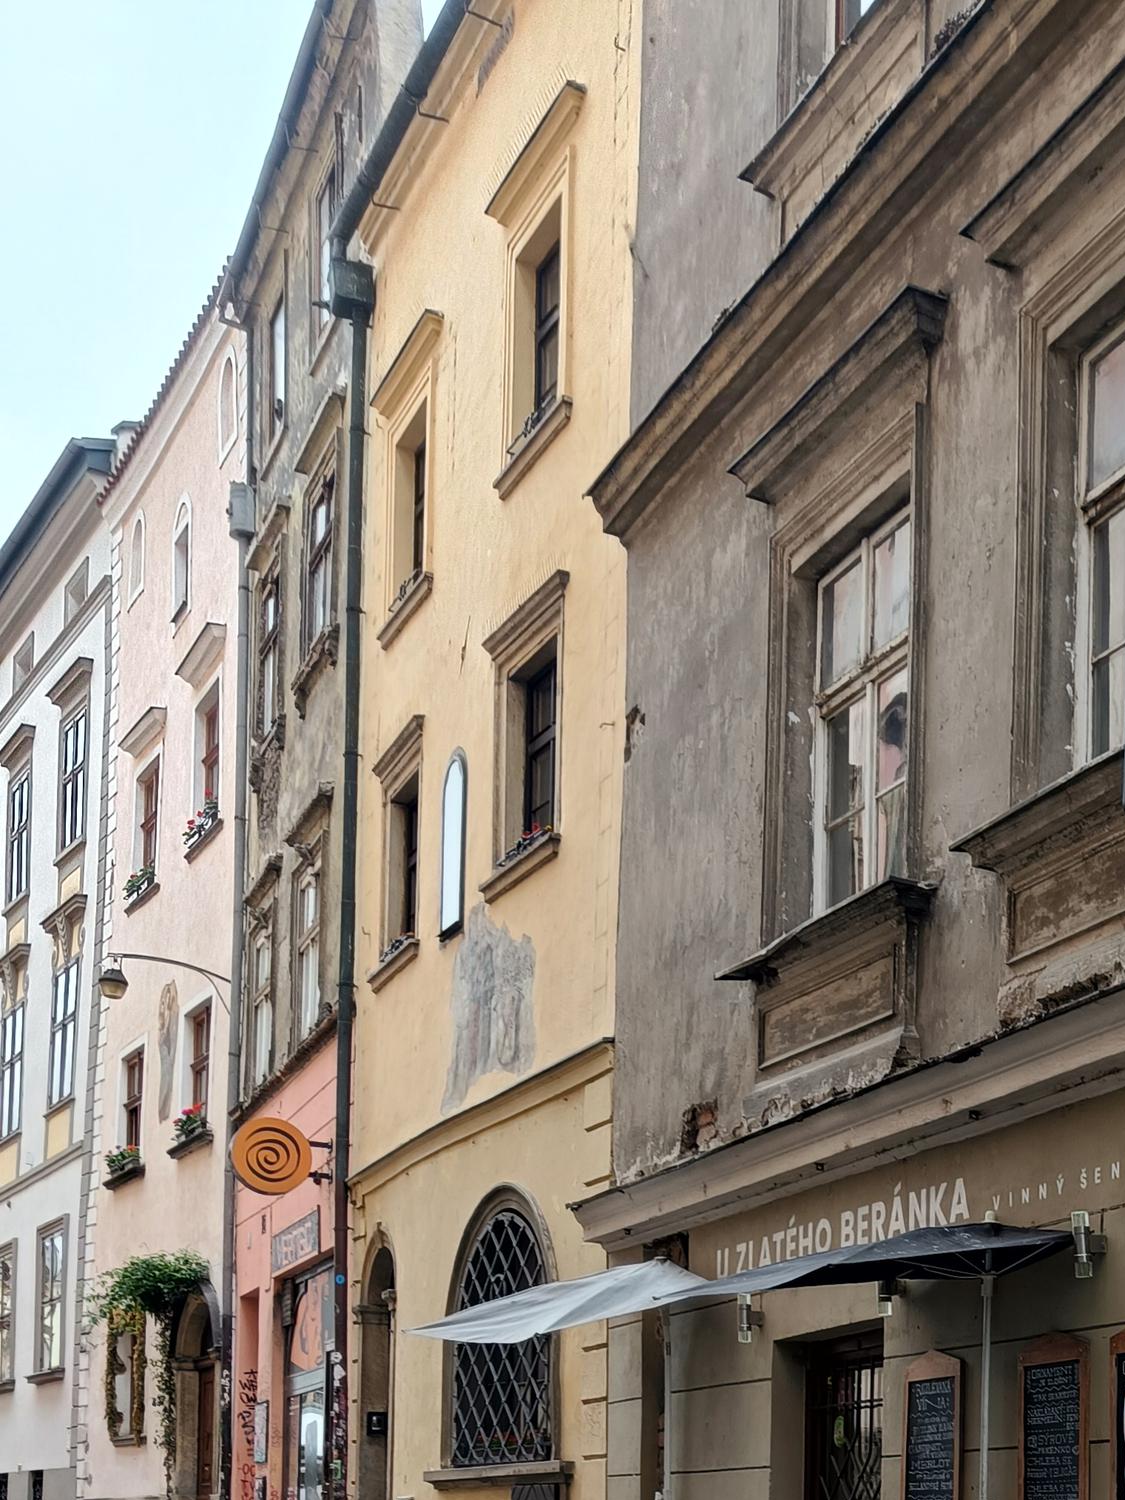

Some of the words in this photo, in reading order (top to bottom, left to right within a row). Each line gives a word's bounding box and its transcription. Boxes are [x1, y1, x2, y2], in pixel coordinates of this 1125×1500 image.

[992, 1173, 1065, 1211] VINNÝ
[716, 1249, 729, 1279] U
[736, 1214, 832, 1271] ZLATÉHO
[840, 1177, 970, 1248] BERÁNKA
